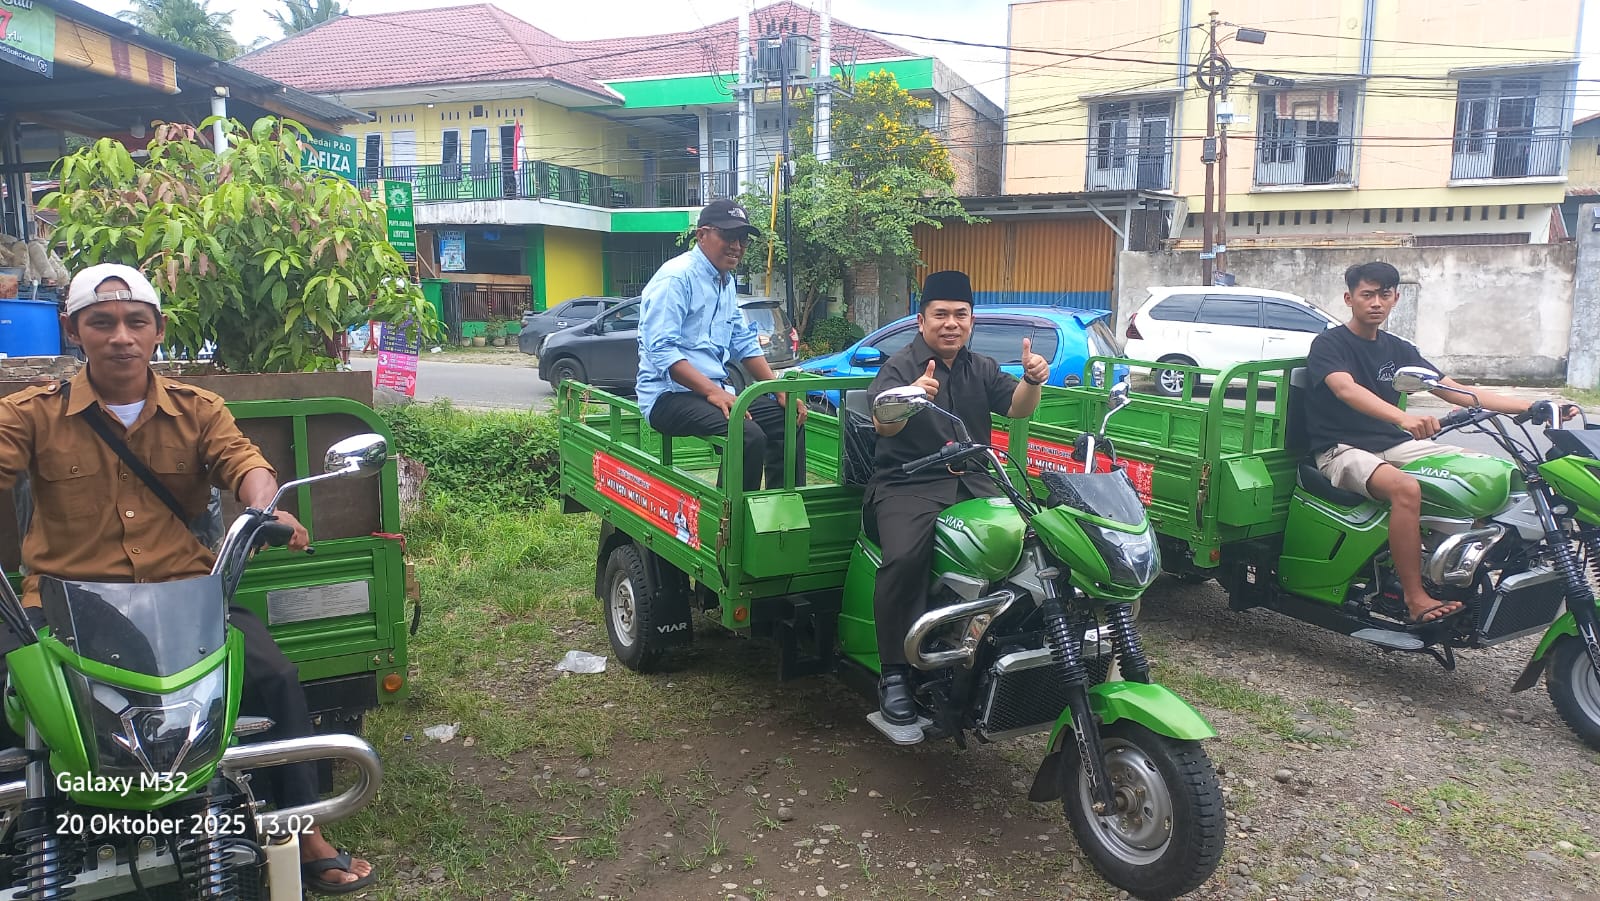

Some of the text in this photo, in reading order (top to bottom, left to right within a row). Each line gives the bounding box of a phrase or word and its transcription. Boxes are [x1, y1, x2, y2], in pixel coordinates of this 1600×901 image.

[309, 138, 351, 152] edai P&D
[1420, 466, 1450, 478] VIAR
[945, 514, 965, 531] VIAR
[656, 622, 688, 634] VIAR
